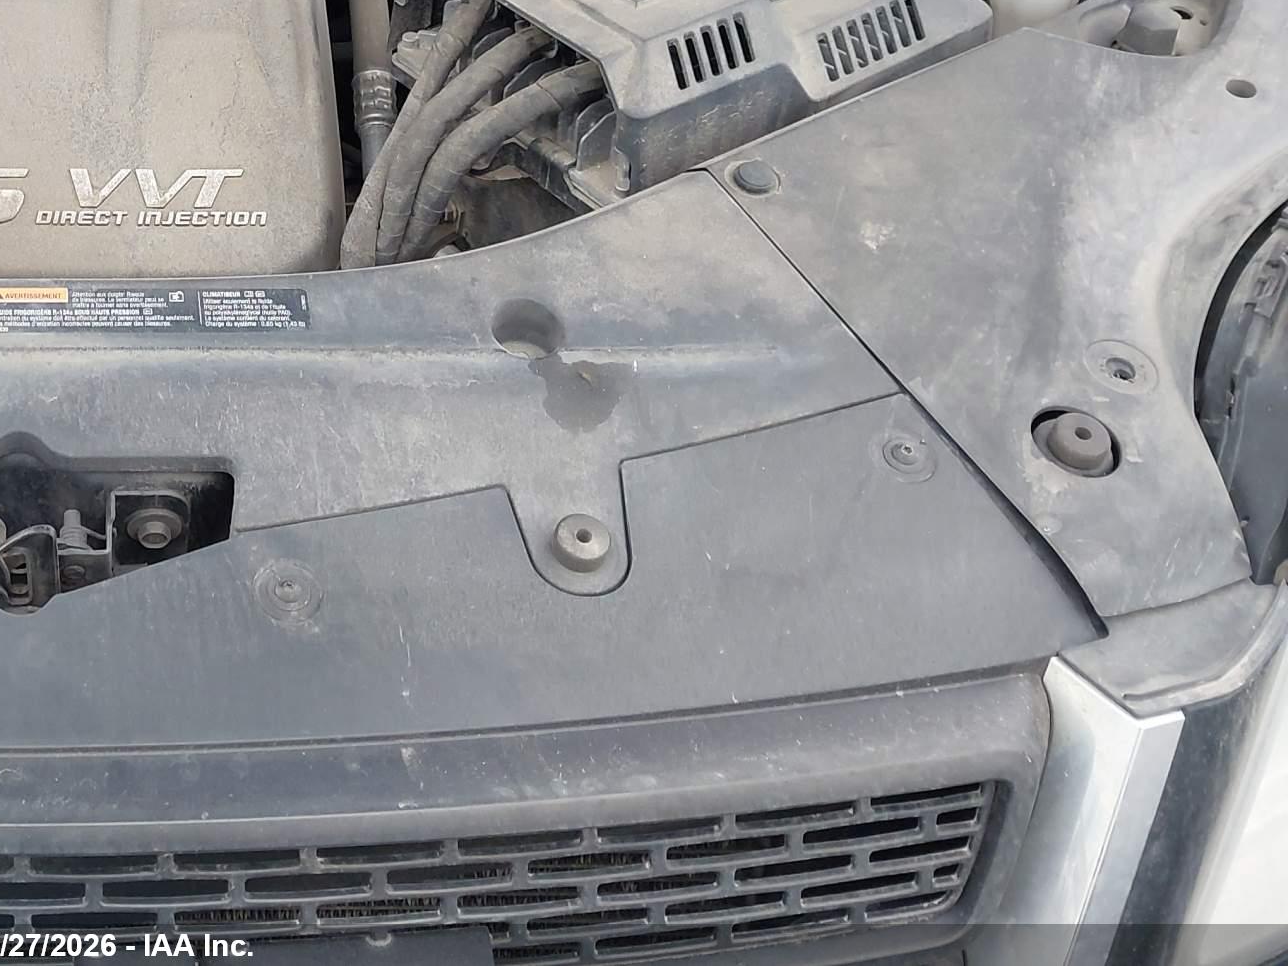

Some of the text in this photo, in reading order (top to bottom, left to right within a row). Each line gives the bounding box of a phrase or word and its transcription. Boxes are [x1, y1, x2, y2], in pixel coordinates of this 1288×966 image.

[68, 168, 244, 209] VVT
[35, 211, 268, 227] DIRECT INJECTION
